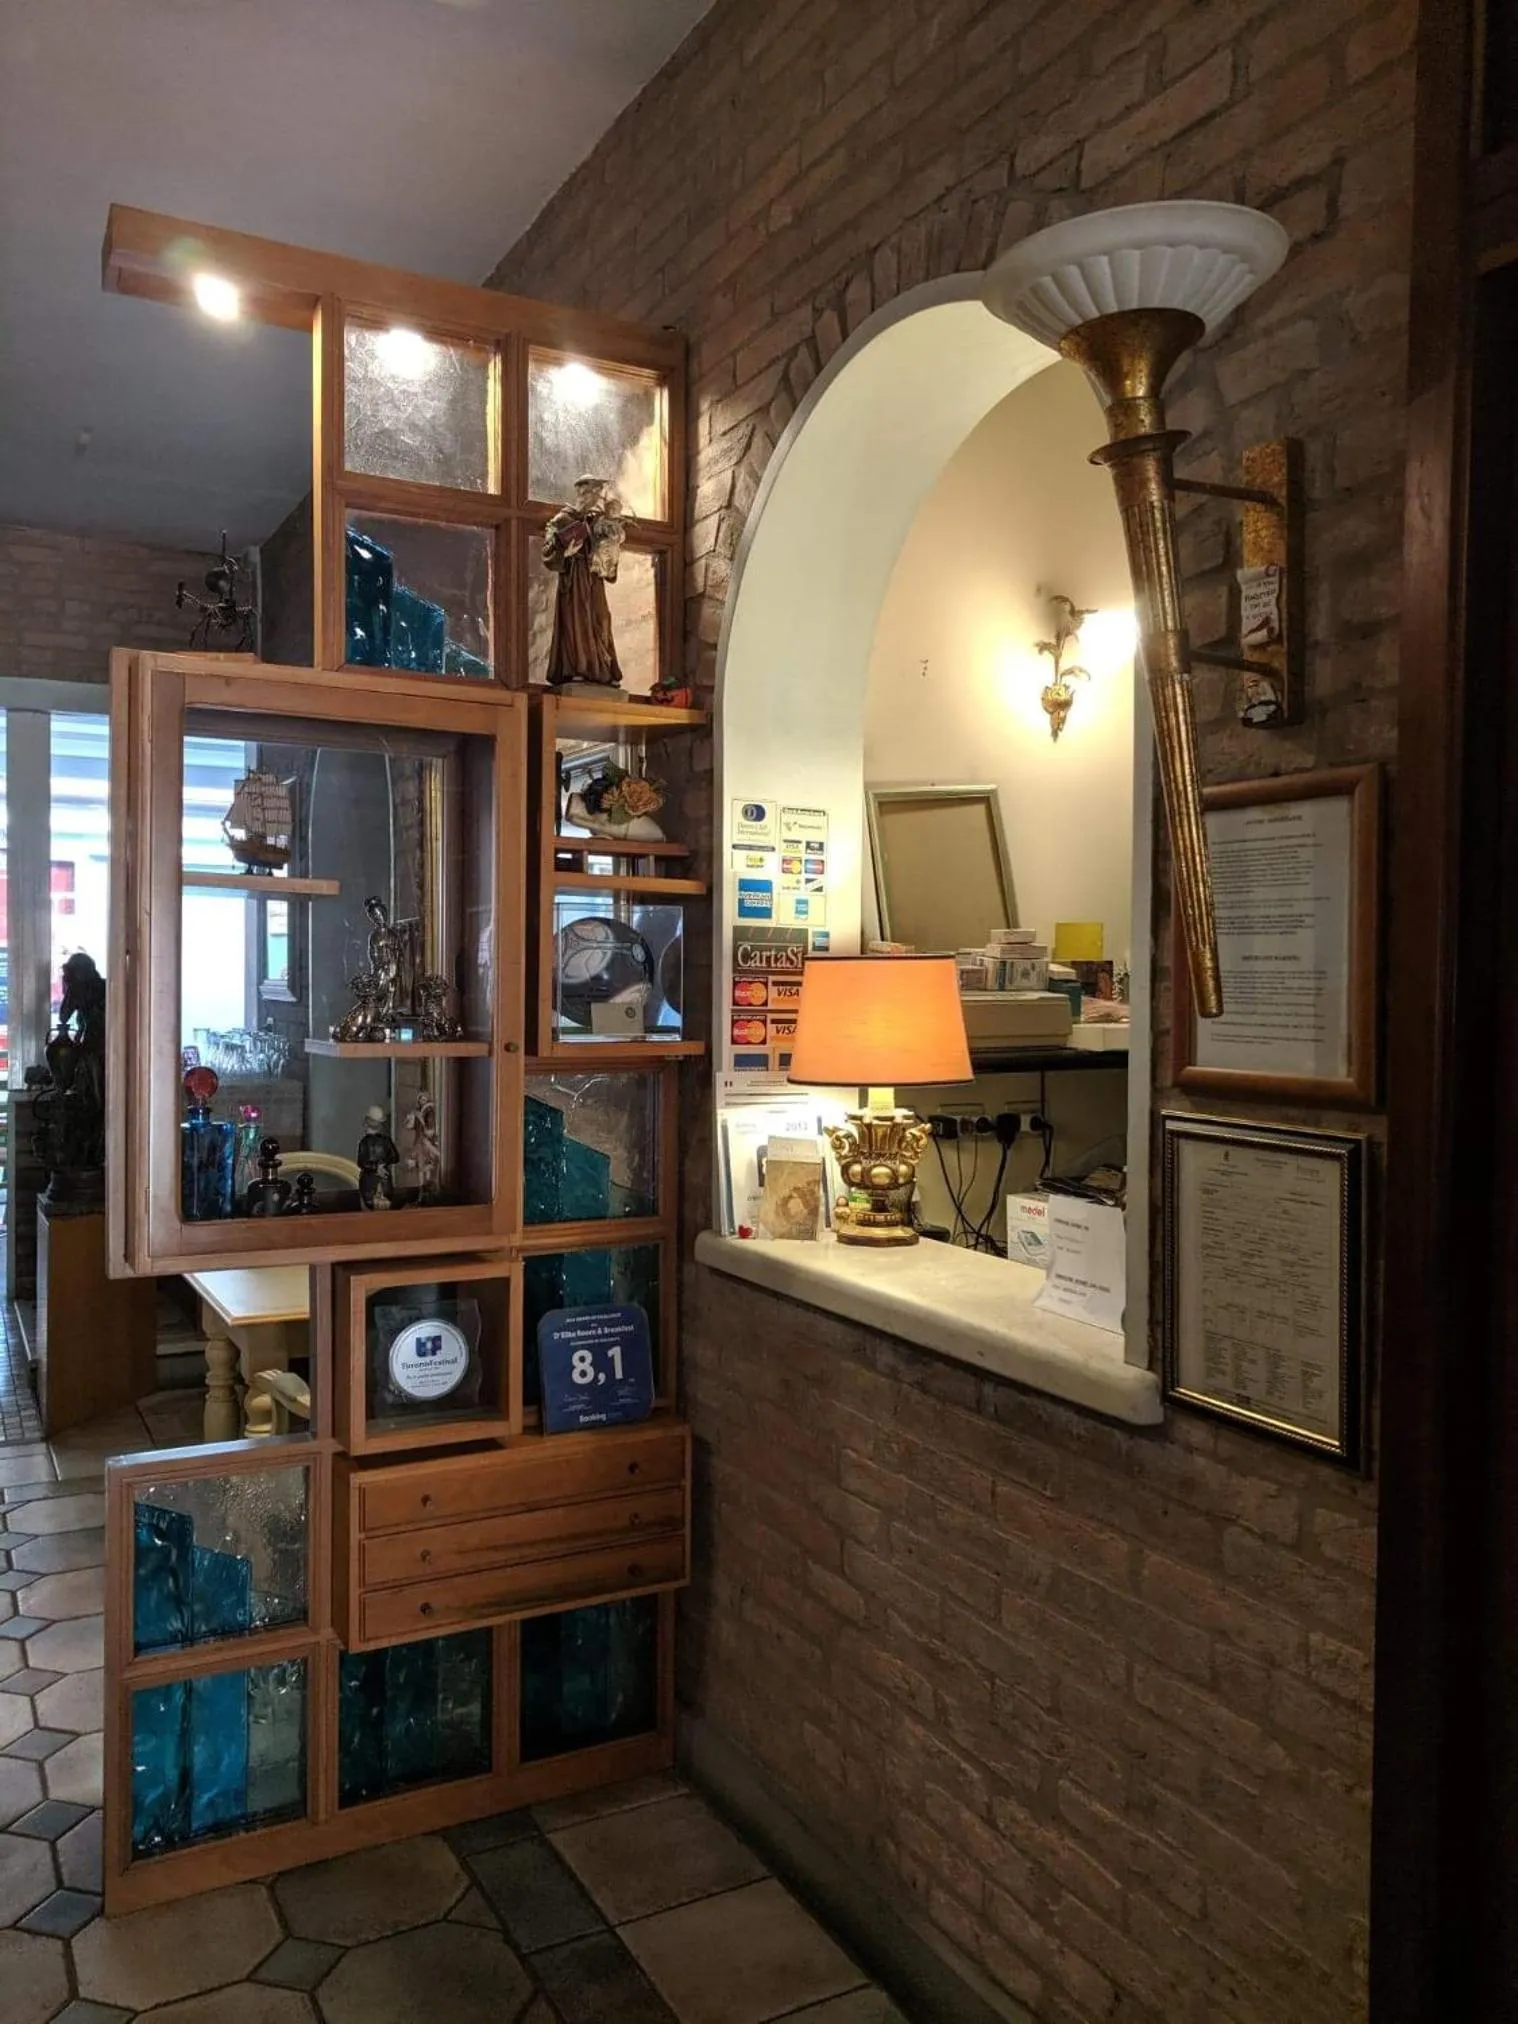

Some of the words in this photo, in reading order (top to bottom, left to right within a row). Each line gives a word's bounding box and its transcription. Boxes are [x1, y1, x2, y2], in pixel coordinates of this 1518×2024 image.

[777, 987, 800, 997] VISA
[1020, 1204, 1046, 1217] medel
[571, 1346, 624, 1386] 8,1
